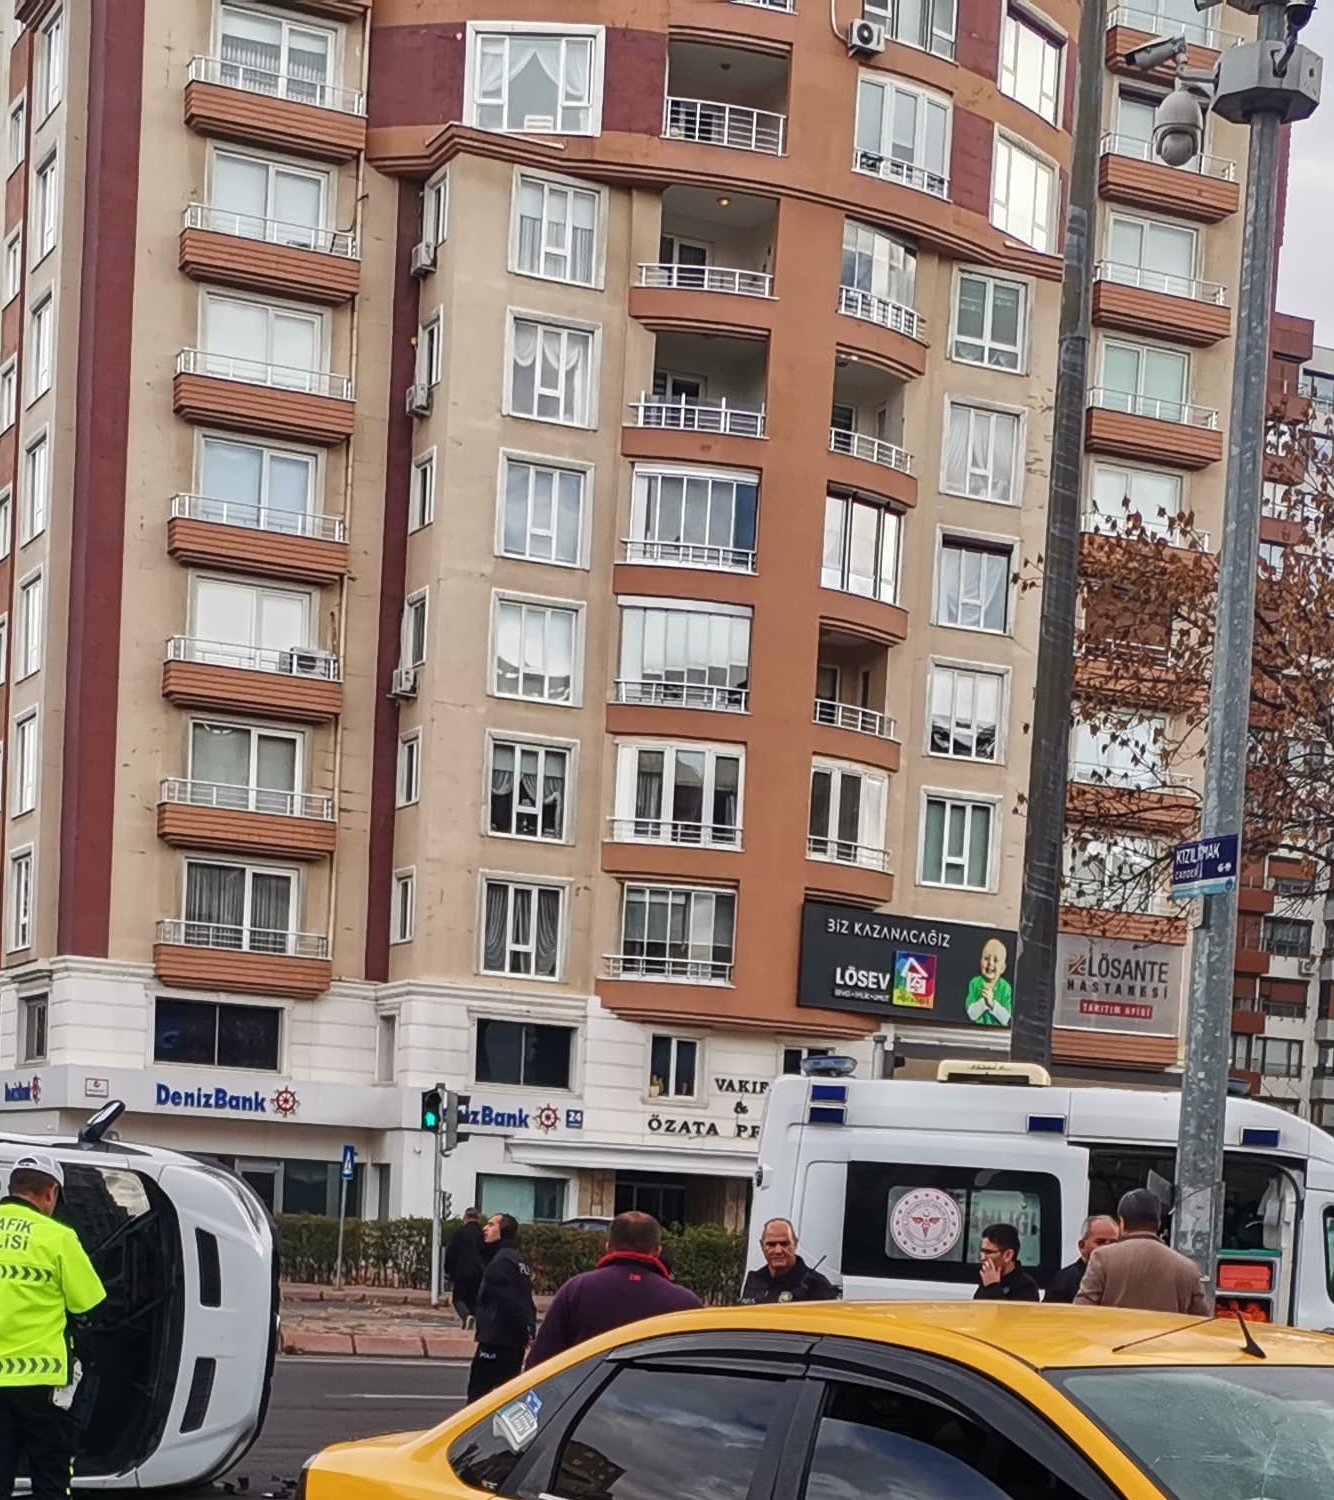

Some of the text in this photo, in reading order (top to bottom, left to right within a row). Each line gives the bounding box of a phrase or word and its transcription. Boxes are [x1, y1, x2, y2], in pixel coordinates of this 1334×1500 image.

[1176, 842, 1221, 866] KIZILMAK
[854, 921, 951, 948] KAZANACAĞIZ
[835, 966, 891, 990] LÖSEV
[1088, 952, 1169, 983] LÖSANTE
[1067, 979, 1168, 999] HASTANESİ
[155, 1083, 267, 1112] DenizBank
[734, 1101, 748, 1114] &
[648, 1114, 719, 1135] ÖZATA
